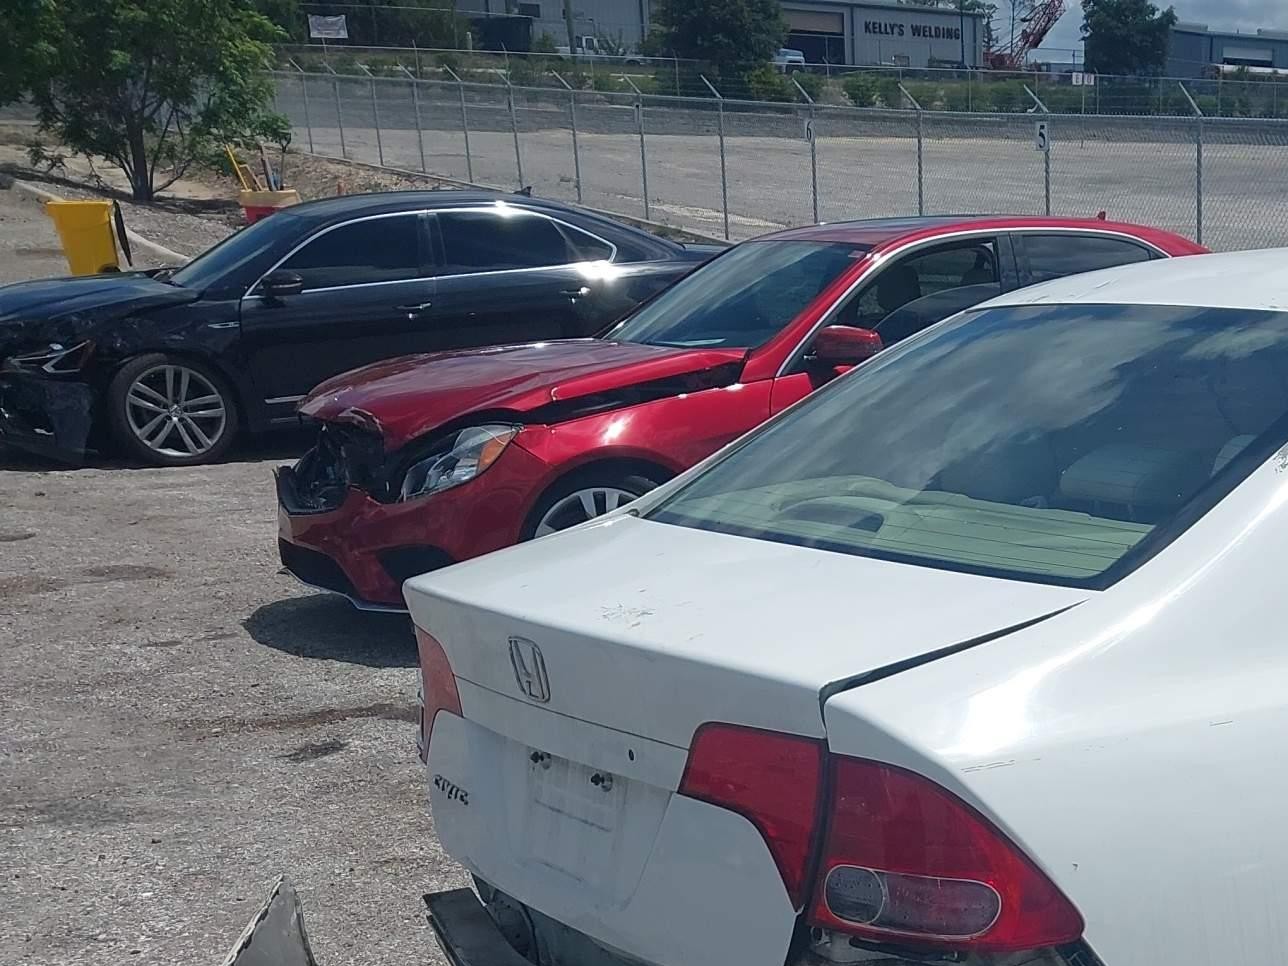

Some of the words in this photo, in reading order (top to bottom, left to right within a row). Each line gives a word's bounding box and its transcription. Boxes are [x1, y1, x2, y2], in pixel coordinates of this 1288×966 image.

[864, 20, 905, 36] KELLY'S
[911, 24, 960, 40] WELDING
[1038, 124, 1046, 149] 5
